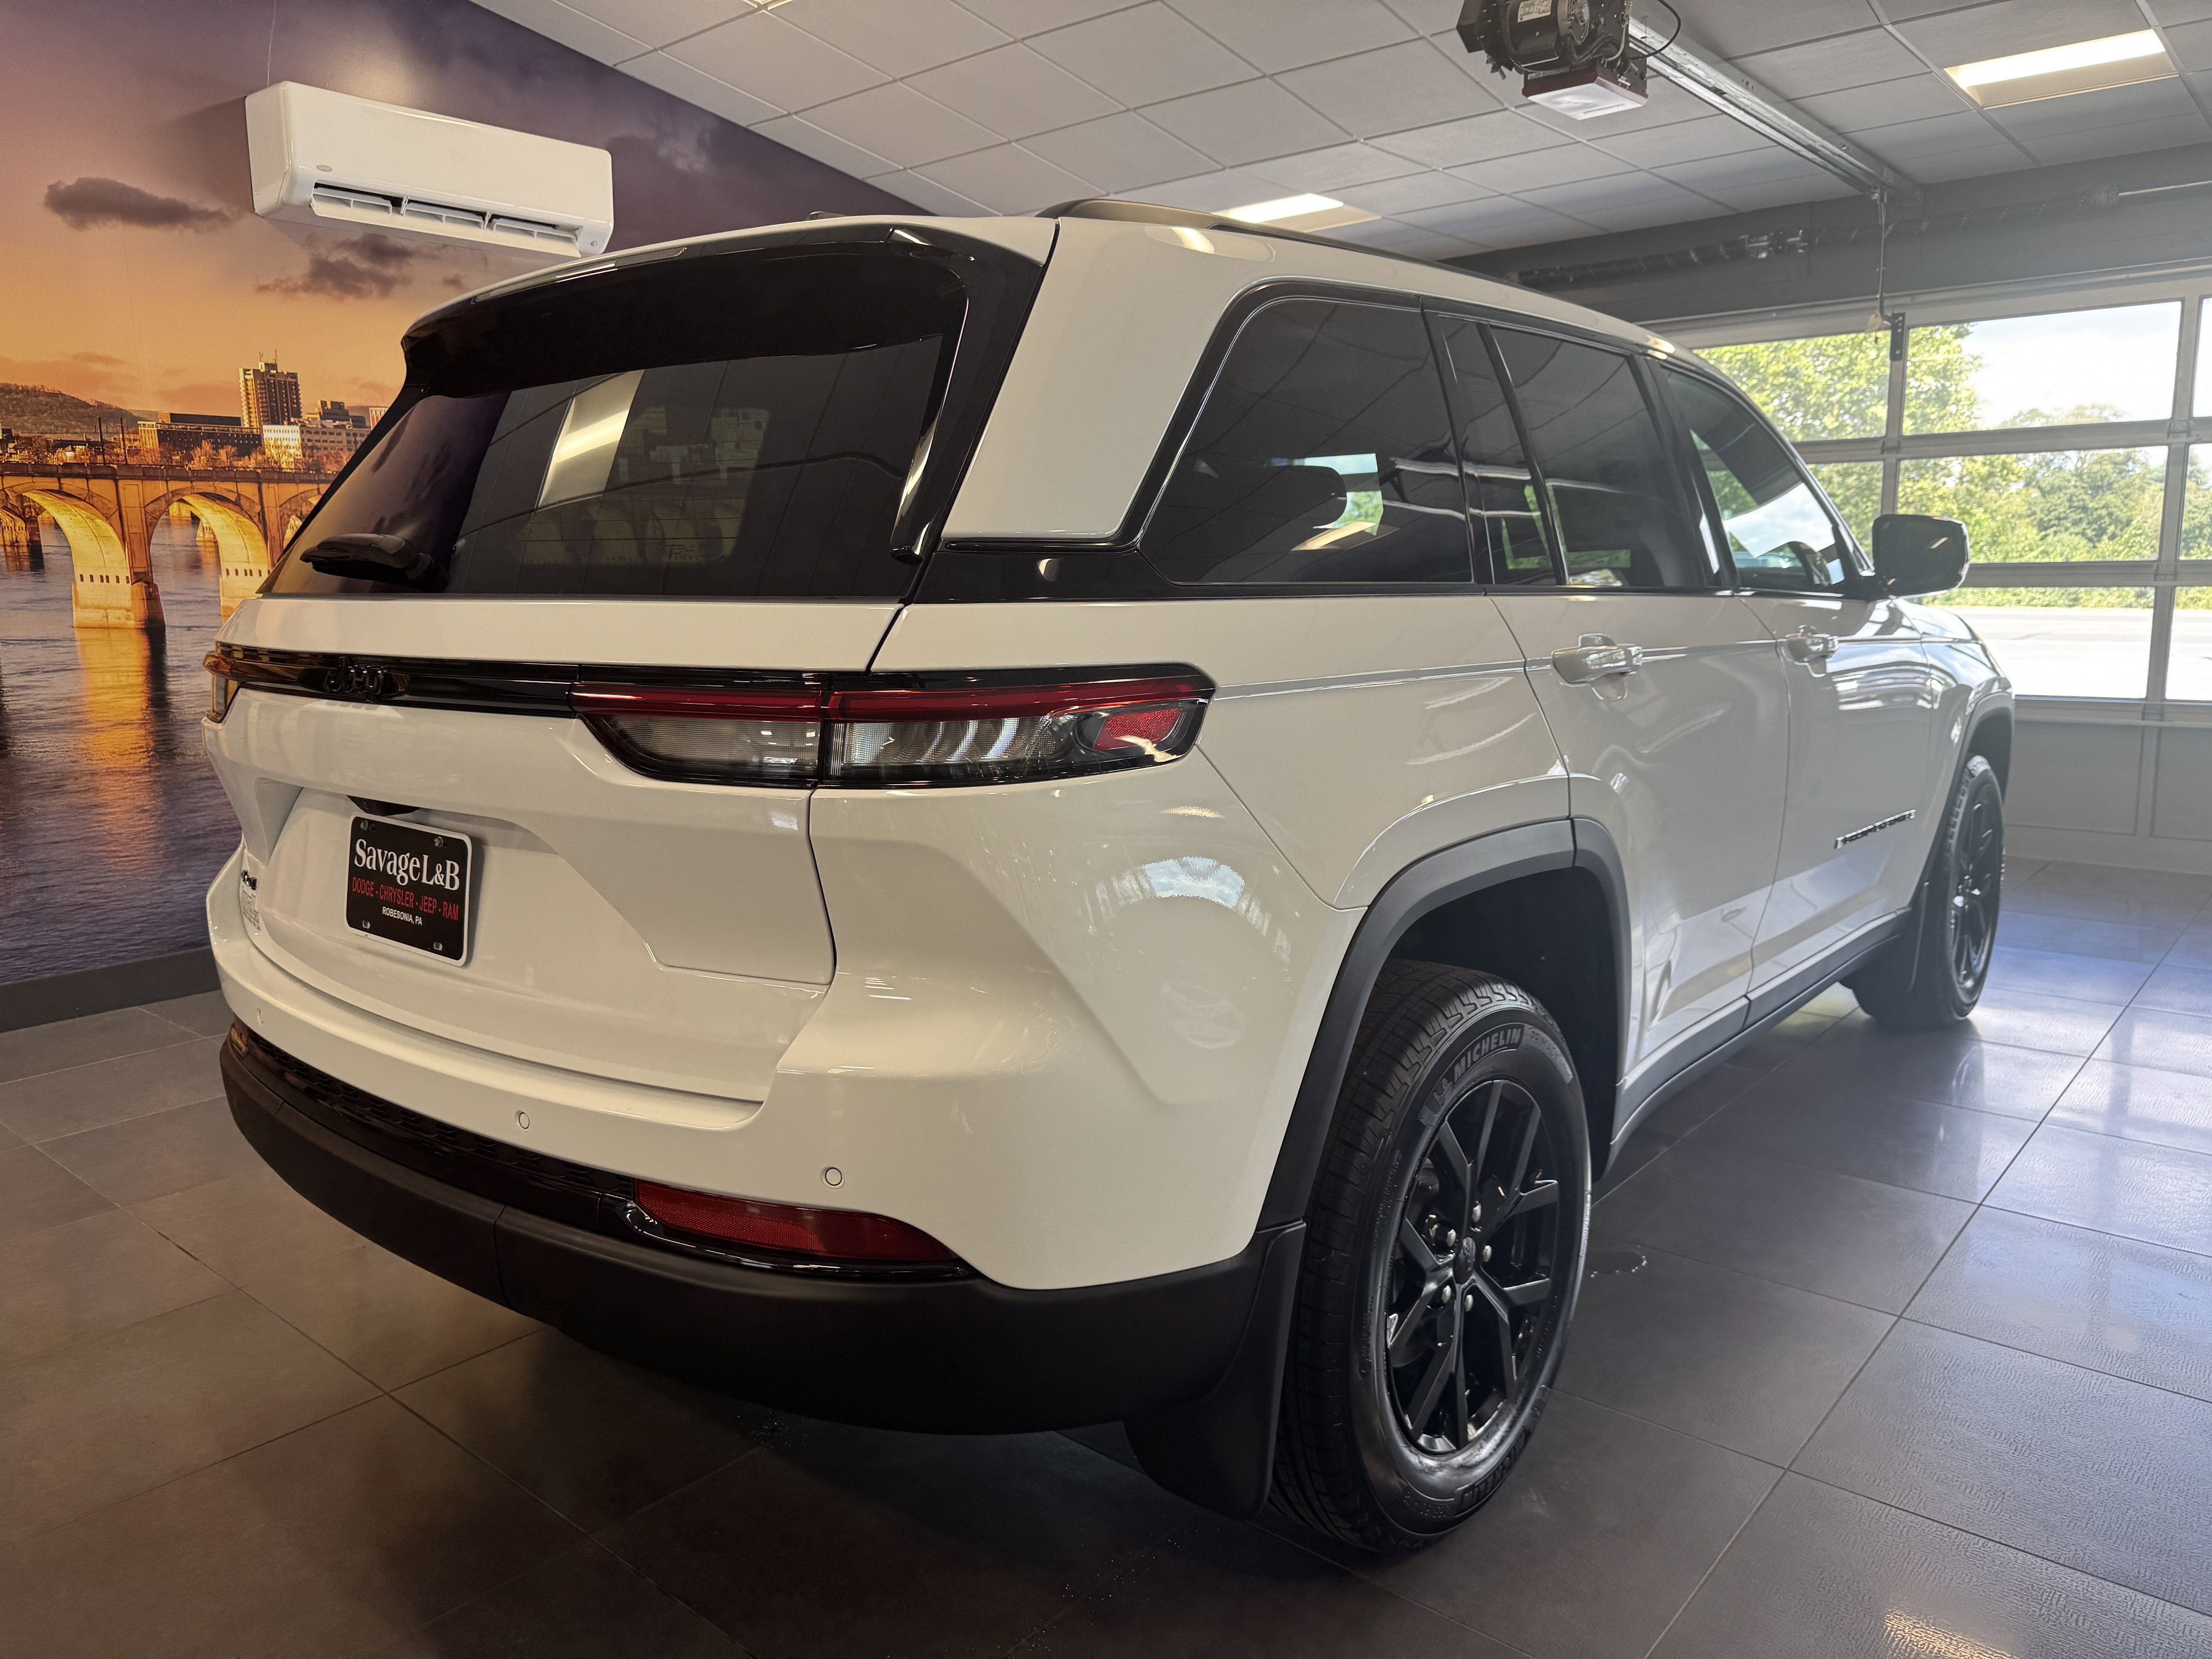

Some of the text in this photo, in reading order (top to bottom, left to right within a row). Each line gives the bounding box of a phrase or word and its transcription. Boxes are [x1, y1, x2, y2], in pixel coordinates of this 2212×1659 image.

[352, 877, 459, 921] DODGE CHRYSLER JEEP RAM
[382, 907, 422, 926] ROBESONIA, PA
[1453, 1027, 1559, 1082] MICHELIN PRIMACY
